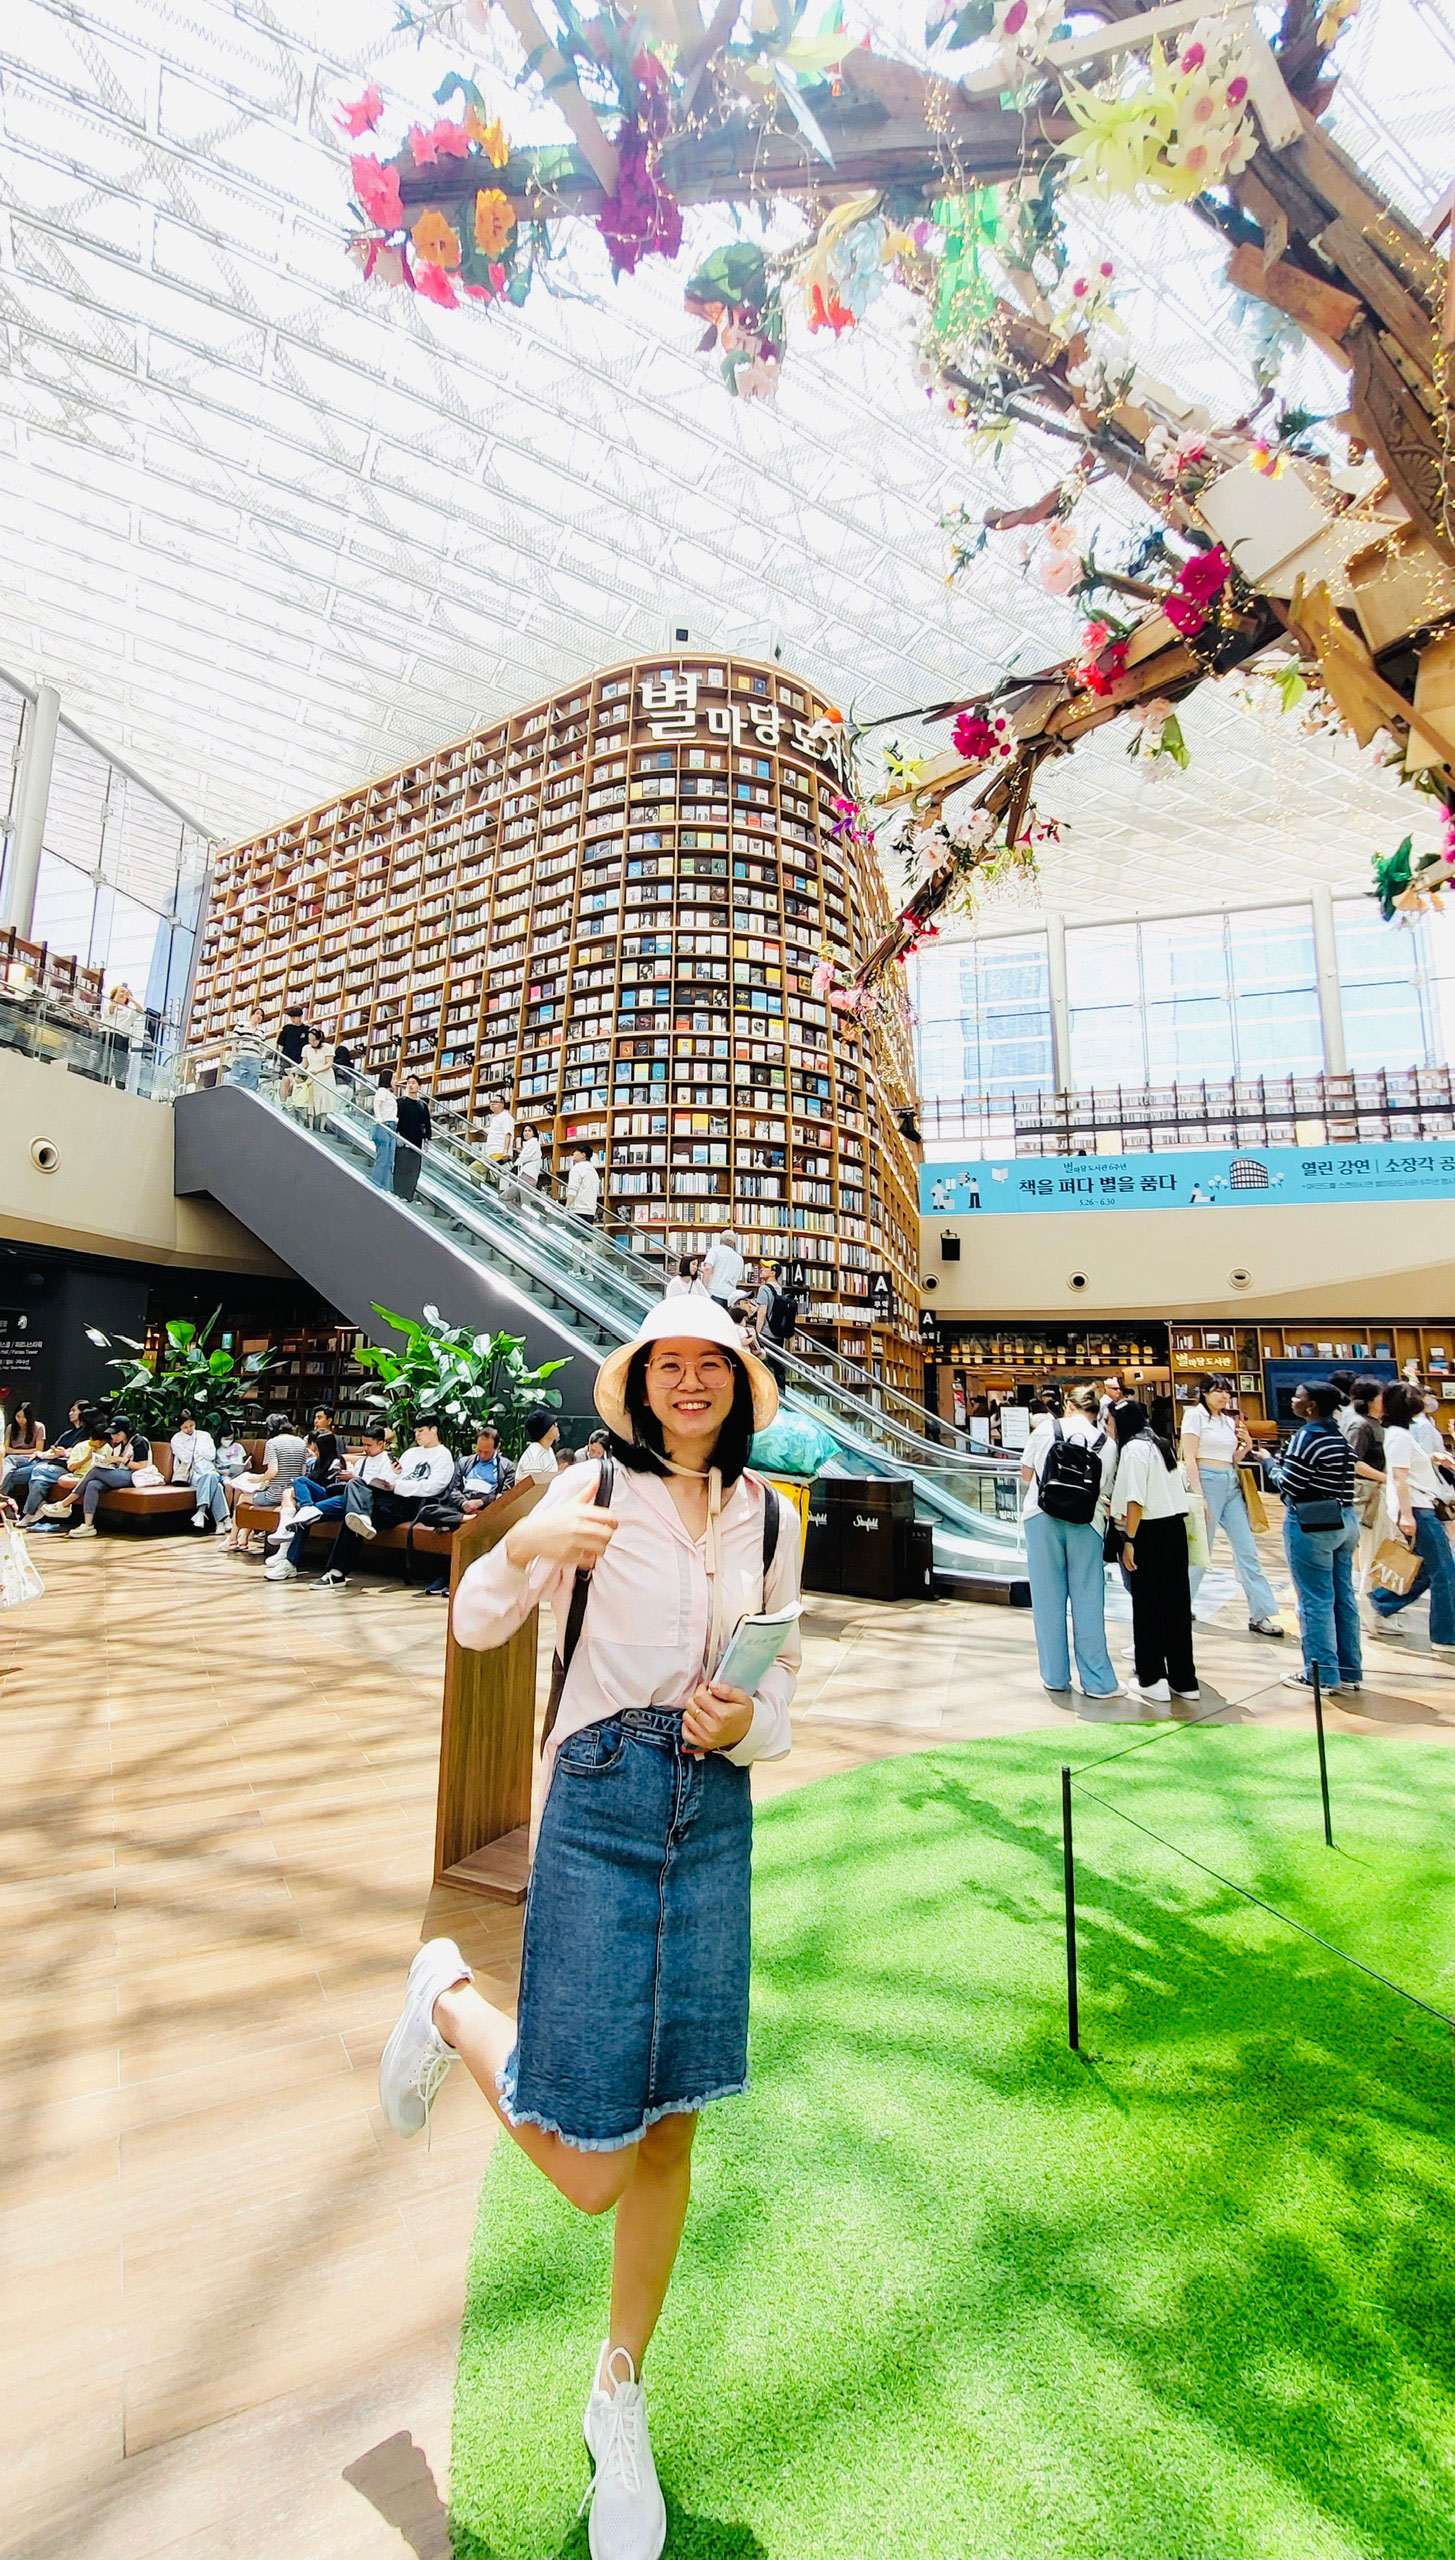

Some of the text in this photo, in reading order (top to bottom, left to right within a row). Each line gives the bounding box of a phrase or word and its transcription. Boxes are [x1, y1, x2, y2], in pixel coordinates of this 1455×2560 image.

[1301, 1161, 1333, 1177] 열린
[1338, 1159, 1370, 1175] 강연
[1385, 1156, 1434, 1173] 소장각
[1019, 1174, 1177, 1195] 책을 펴다 별을 품다
[794, 1264, 803, 1282] A
[874, 1275, 888, 1292] A
[922, 1312, 933, 1325] A
[1175, 1352, 1231, 1368] 별마당도서관
